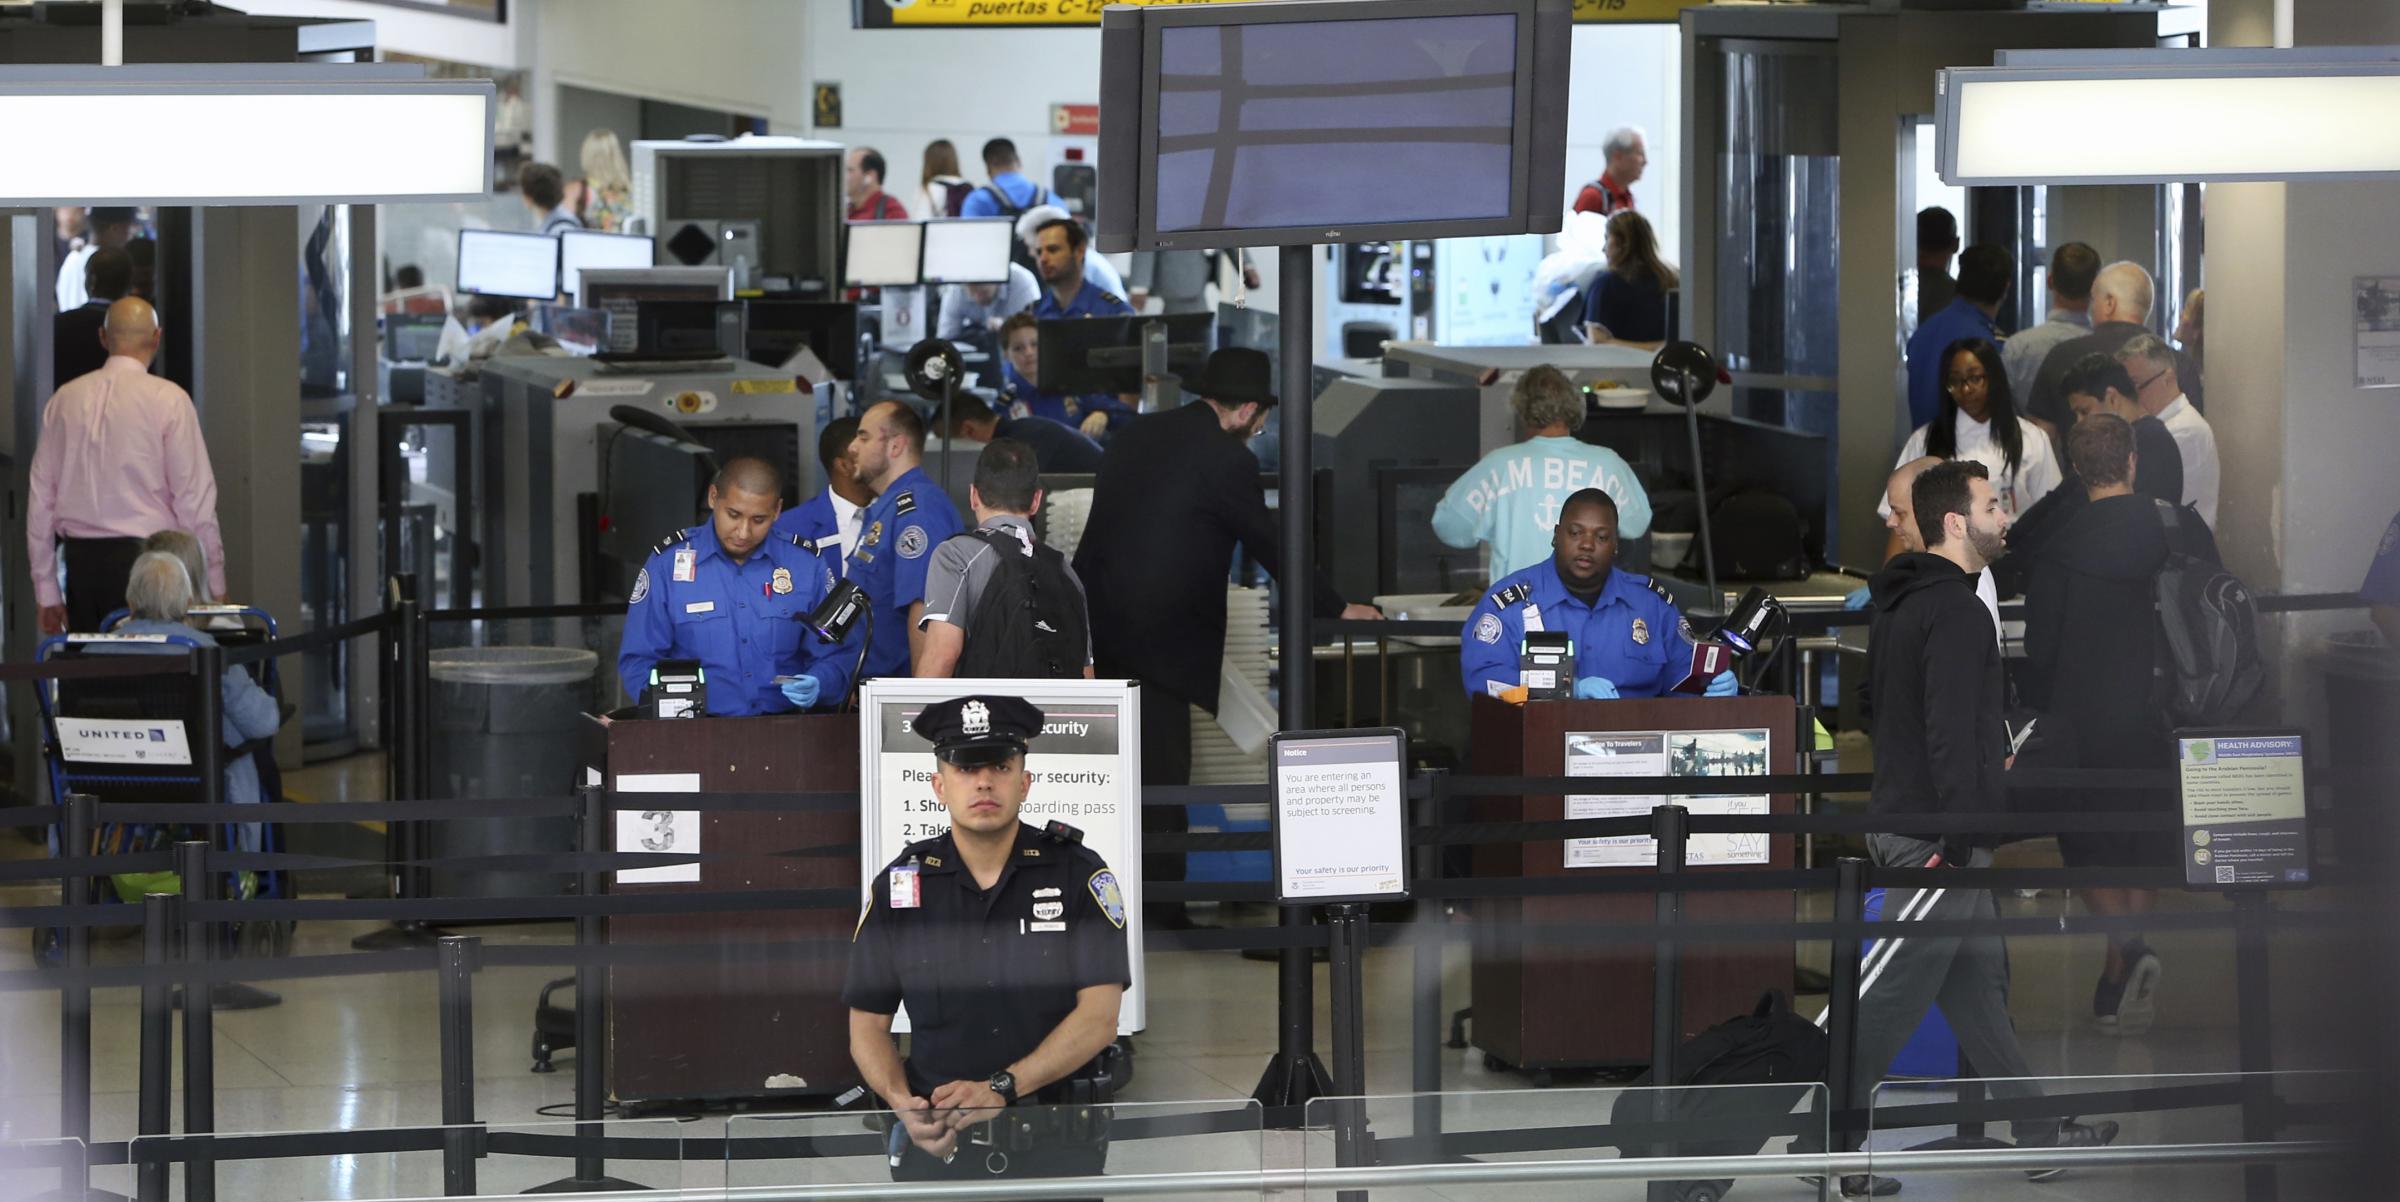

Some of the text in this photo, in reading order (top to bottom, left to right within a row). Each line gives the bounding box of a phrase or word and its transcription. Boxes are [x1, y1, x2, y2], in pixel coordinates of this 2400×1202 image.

[968, 0, 1048, 18] puertas
[1466, 456, 1534, 514] PALM
[1502, 588, 1516, 603] TSA
[79, 730, 145, 740] UNITED
[1041, 721, 1089, 737] ecurity
[2217, 742, 2249, 750] HEALTH
[1284, 749, 1307, 757] Notice
[903, 769, 1110, 786] Plea or security:
[1286, 774, 1302, 782] You
[1321, 772, 1359, 782] entering
[1361, 772, 1371, 780] an
[1286, 783, 1386, 794] area where all persons
[1287, 794, 1380, 806] and property may be
[1734, 801, 1747, 809] you
[904, 800, 916, 812] 1.
[920, 800, 946, 812] Sho
[1084, 803, 1116, 816] pass
[1287, 808, 1320, 817] subject
[641, 811, 674, 852] 3
[904, 824, 916, 836] 2.
[1727, 833, 1763, 852] SAY
[1686, 852, 1705, 861] TAS
[1314, 867, 1337, 875] safety
[1361, 864, 1390, 873] priority
